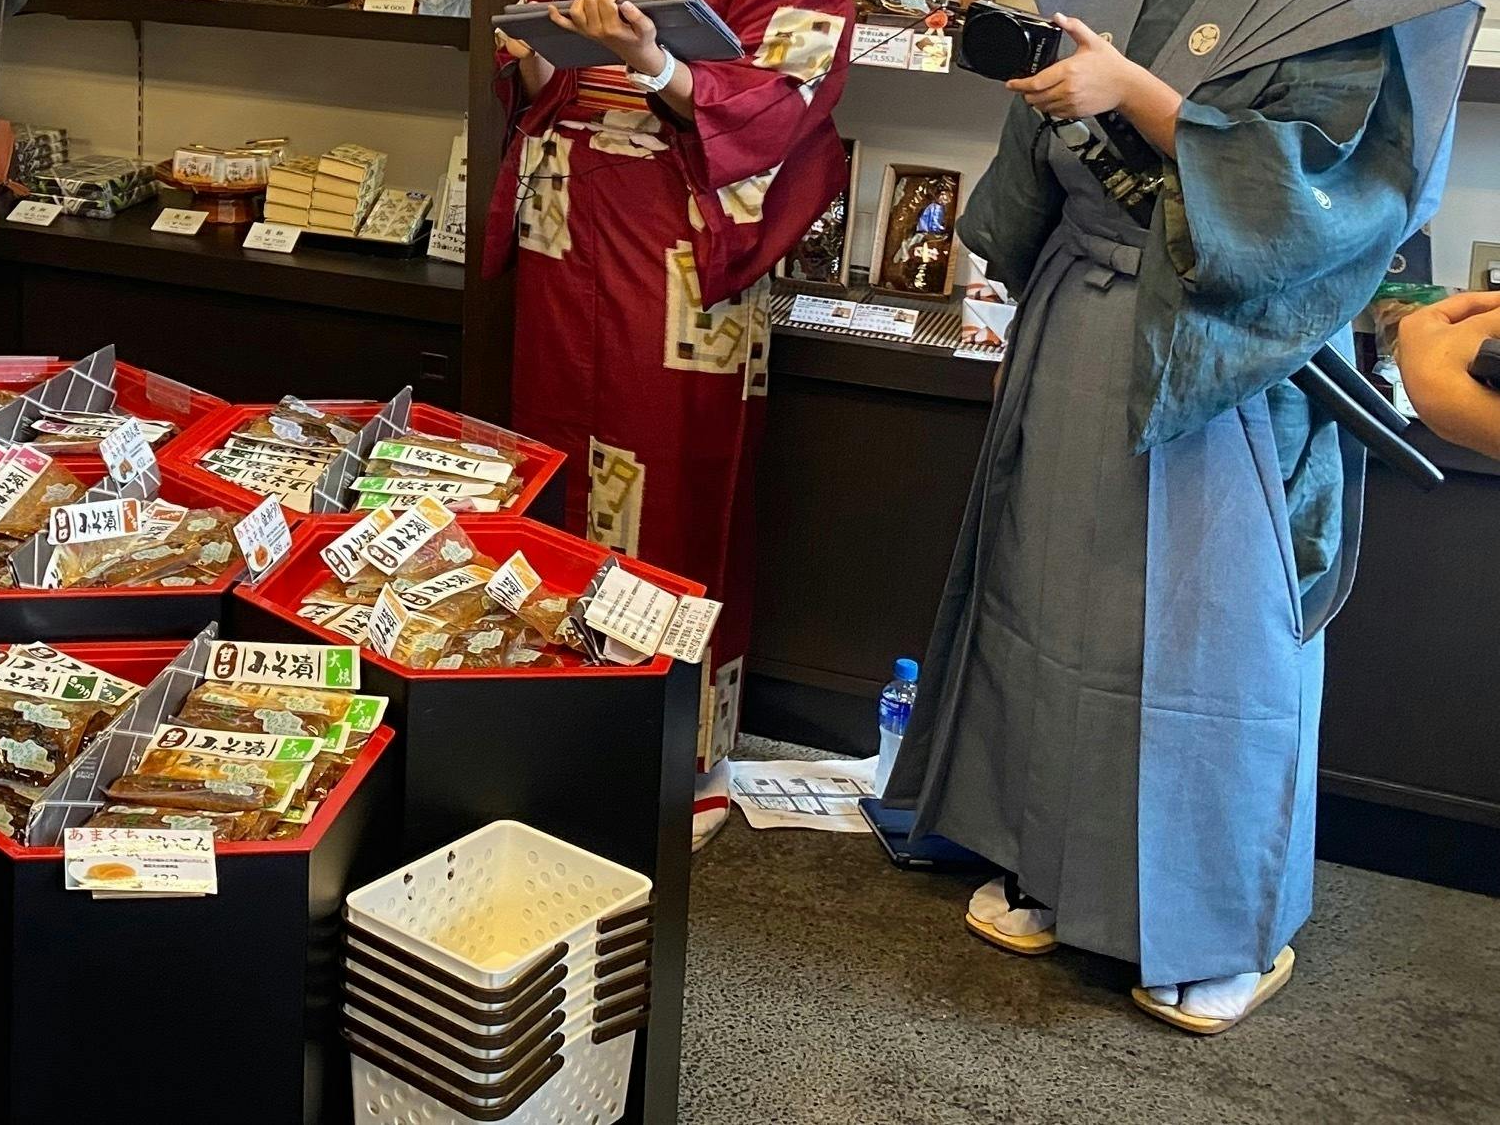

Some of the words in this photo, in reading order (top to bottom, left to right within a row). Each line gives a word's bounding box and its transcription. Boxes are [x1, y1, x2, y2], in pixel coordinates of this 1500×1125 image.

[414, 448, 475, 471] みそ漬
[56, 510, 70, 540] 甘口
[78, 509, 117, 534] みそ漬
[387, 519, 430, 552] みそ漬
[423, 574, 474, 594] みそ漬
[216, 645, 237, 676] 甘口
[247, 650, 314, 680] みそ漬
[326, 649, 352, 684] 大根
[67, 675, 92, 699] きゅうり
[352, 698, 372, 728] 大根
[162, 730, 184, 747] 甘口
[195, 735, 266, 757] みそ漬
[68, 828, 139, 842] あまくち
